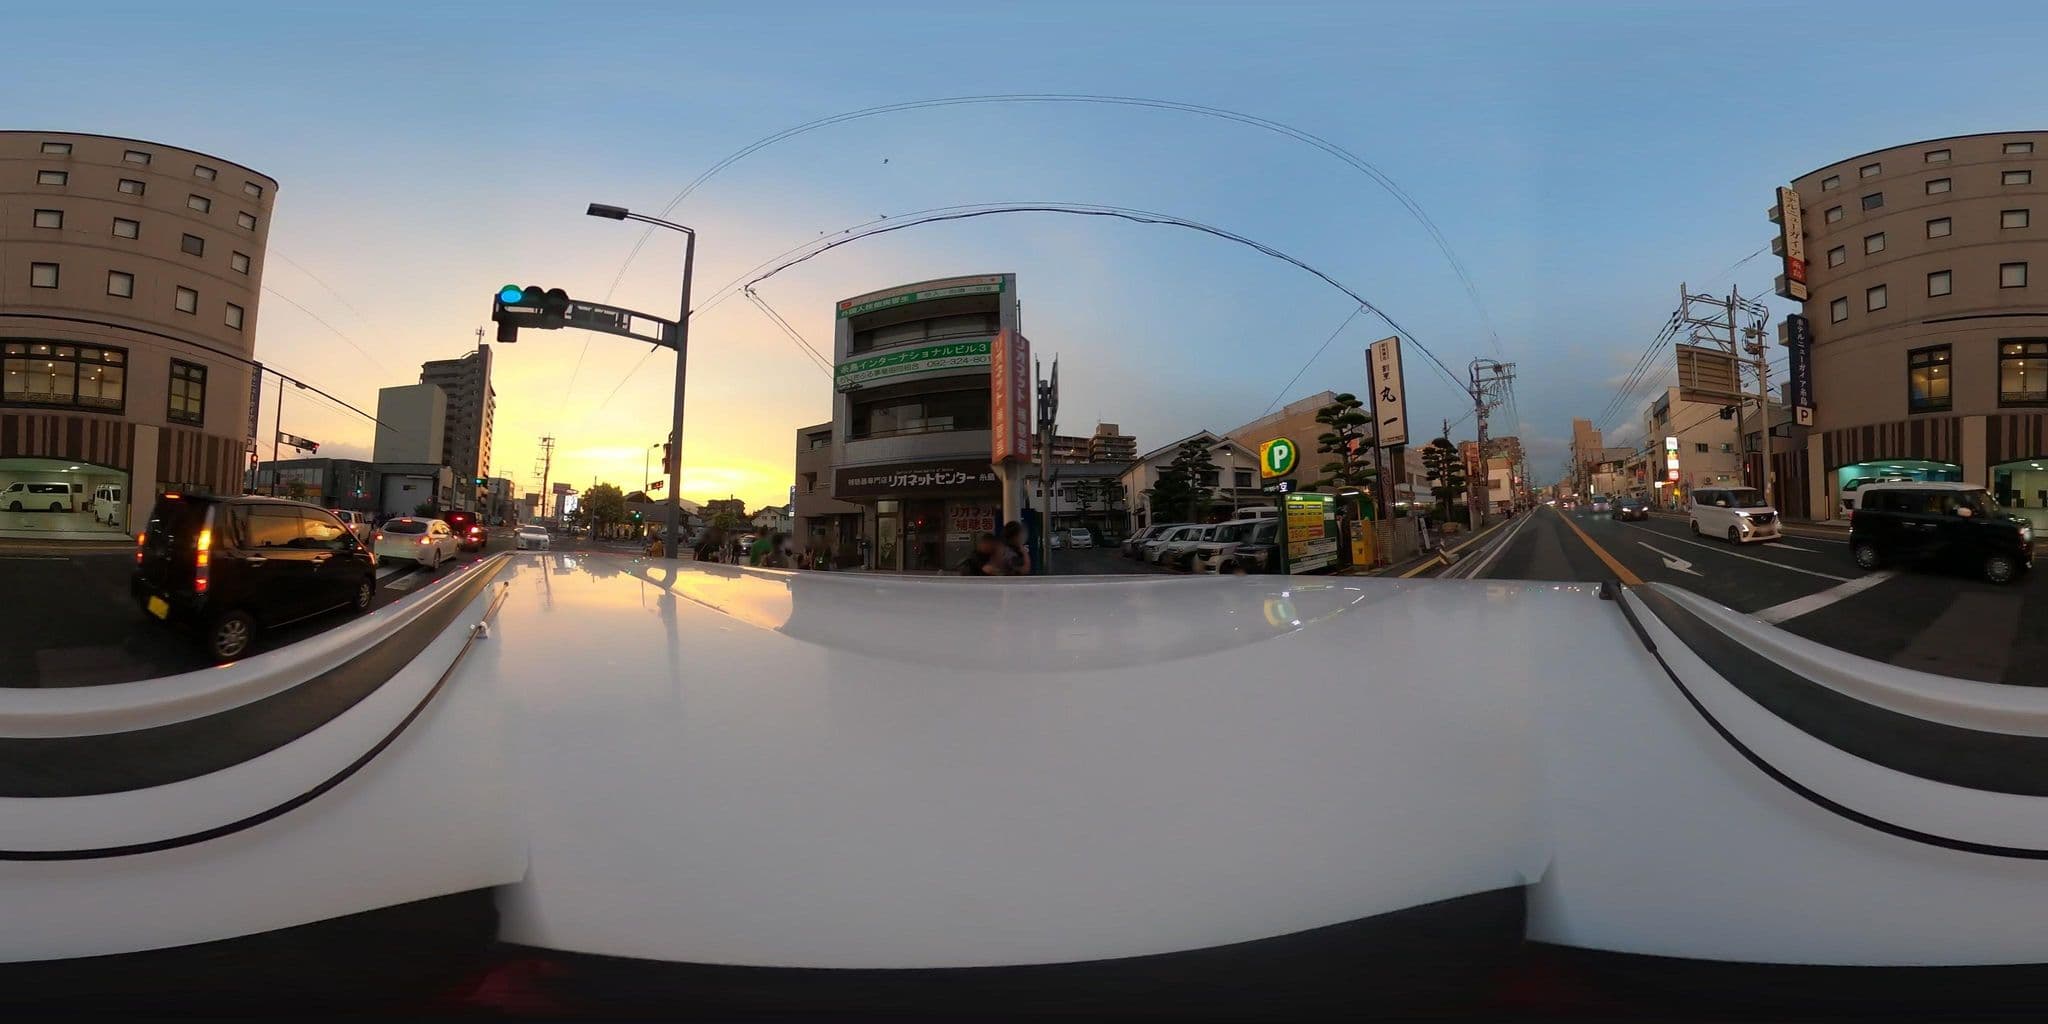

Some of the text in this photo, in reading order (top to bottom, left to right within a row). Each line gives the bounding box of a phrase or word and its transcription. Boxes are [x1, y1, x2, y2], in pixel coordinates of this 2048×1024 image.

[1273, 445, 1288, 469] P
[888, 471, 976, 487] リオネットセンター
